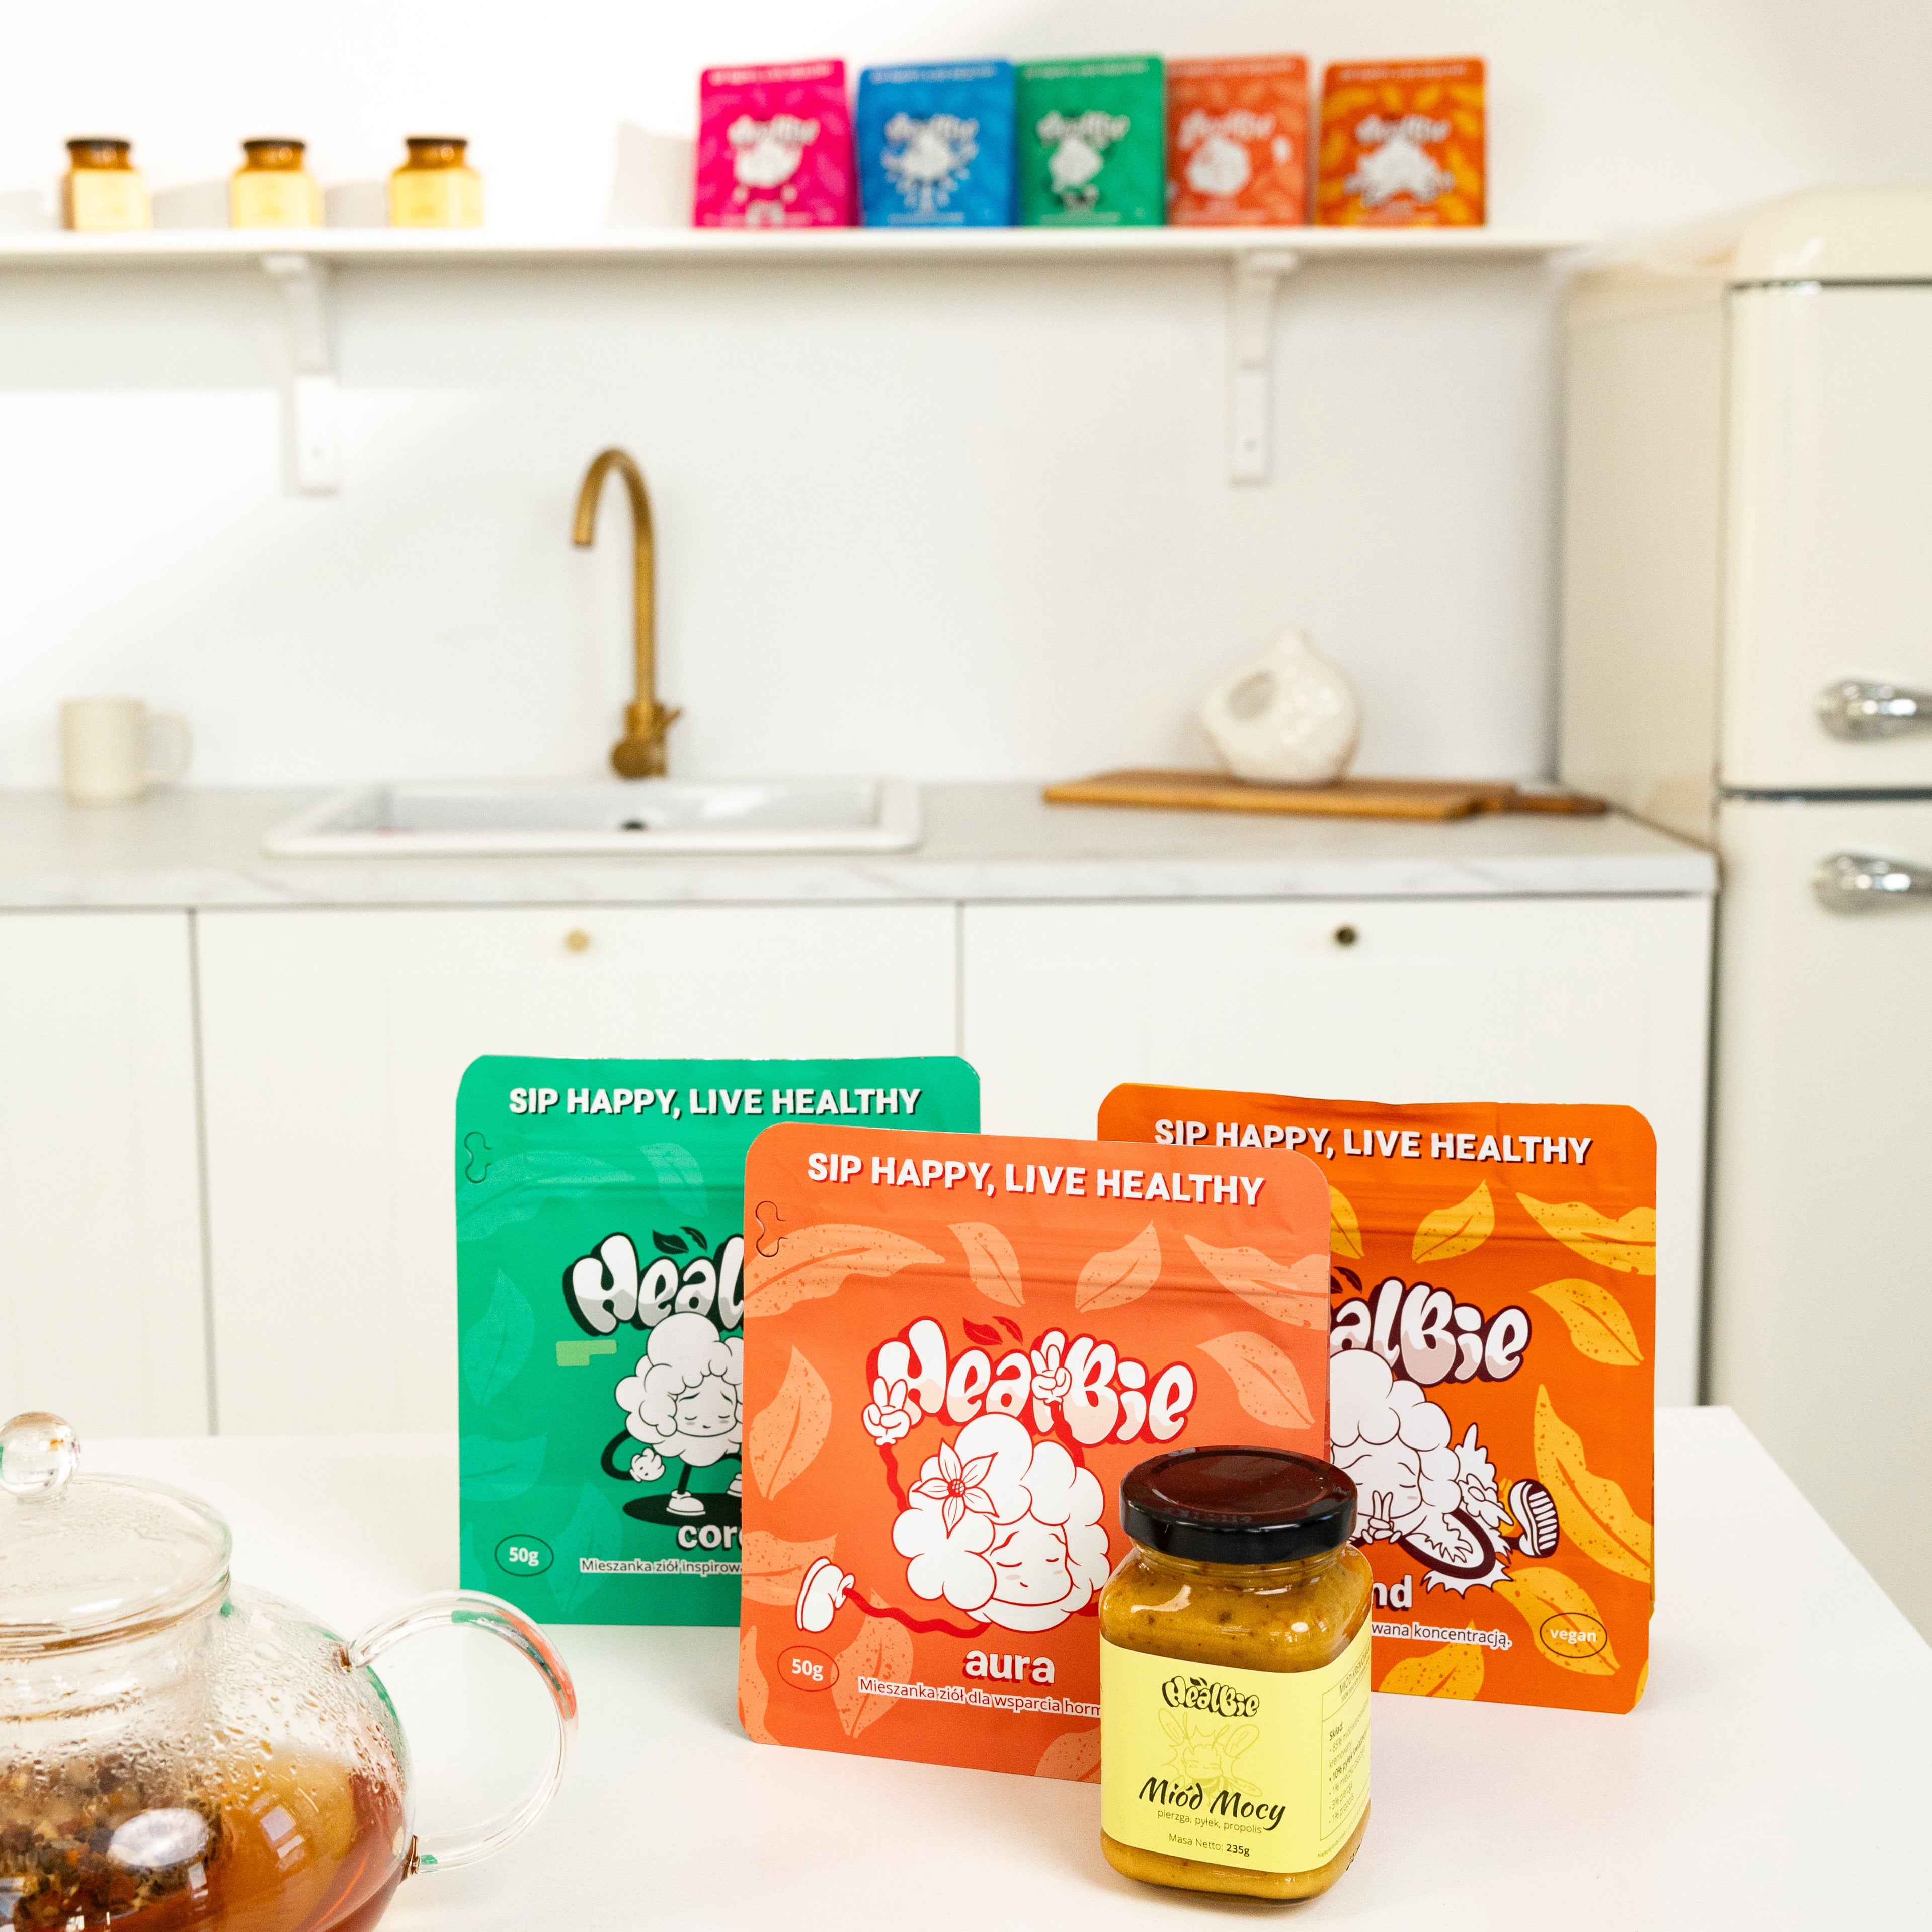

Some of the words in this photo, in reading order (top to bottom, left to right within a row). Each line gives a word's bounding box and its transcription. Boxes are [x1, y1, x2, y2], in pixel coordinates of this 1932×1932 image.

[510, 1088, 558, 1113] SIP
[568, 1089, 679, 1118] HAPPY,
[690, 1089, 761, 1113] LIVE
[773, 1089, 920, 1113] HEALTHY
[1155, 1118, 1206, 1146] SIP
[1216, 1122, 1333, 1159] HAPPY,
[1344, 1129, 1420, 1157] LIVE
[1431, 1132, 1592, 1164] HEALTHY
[807, 1153, 862, 1182] SIP
[871, 1156, 995, 1197] HAPPY,
[1006, 1163, 1086, 1195] LIVE
[1097, 1169, 1264, 1205] HEALTHY
[677, 1525, 742, 1548] cor
[509, 1547, 539, 1566] 50g
[581, 1560, 652, 1572] Mieszanka
[656, 1559, 679, 1572] ziół
[683, 1560, 742, 1575] inspirow
[1414, 1624, 1510, 1648] koncentracją.
[1550, 1628, 1597, 1644] vegan
[792, 1658, 824, 1681] 50g
[966, 1650, 1055, 1683] aura
[860, 1679, 934, 1699] Mieszanka
[939, 1685, 964, 1703] ziół
[969, 1691, 990, 1705] dla
[994, 1696, 1060, 1713] wsparcia
[1139, 1777, 1203, 1810] Miód
[1209, 1790, 1286, 1831] Mocy
[1157, 1809, 1192, 1824] pierzga,
[1195, 1816, 1221, 1829] pyłek,
[1223, 1821, 1262, 1834] propolis
[1169, 1833, 1192, 1845] Masa
[1195, 1839, 1224, 1852] Netto:
[1226, 1843, 1250, 1857] 235g
